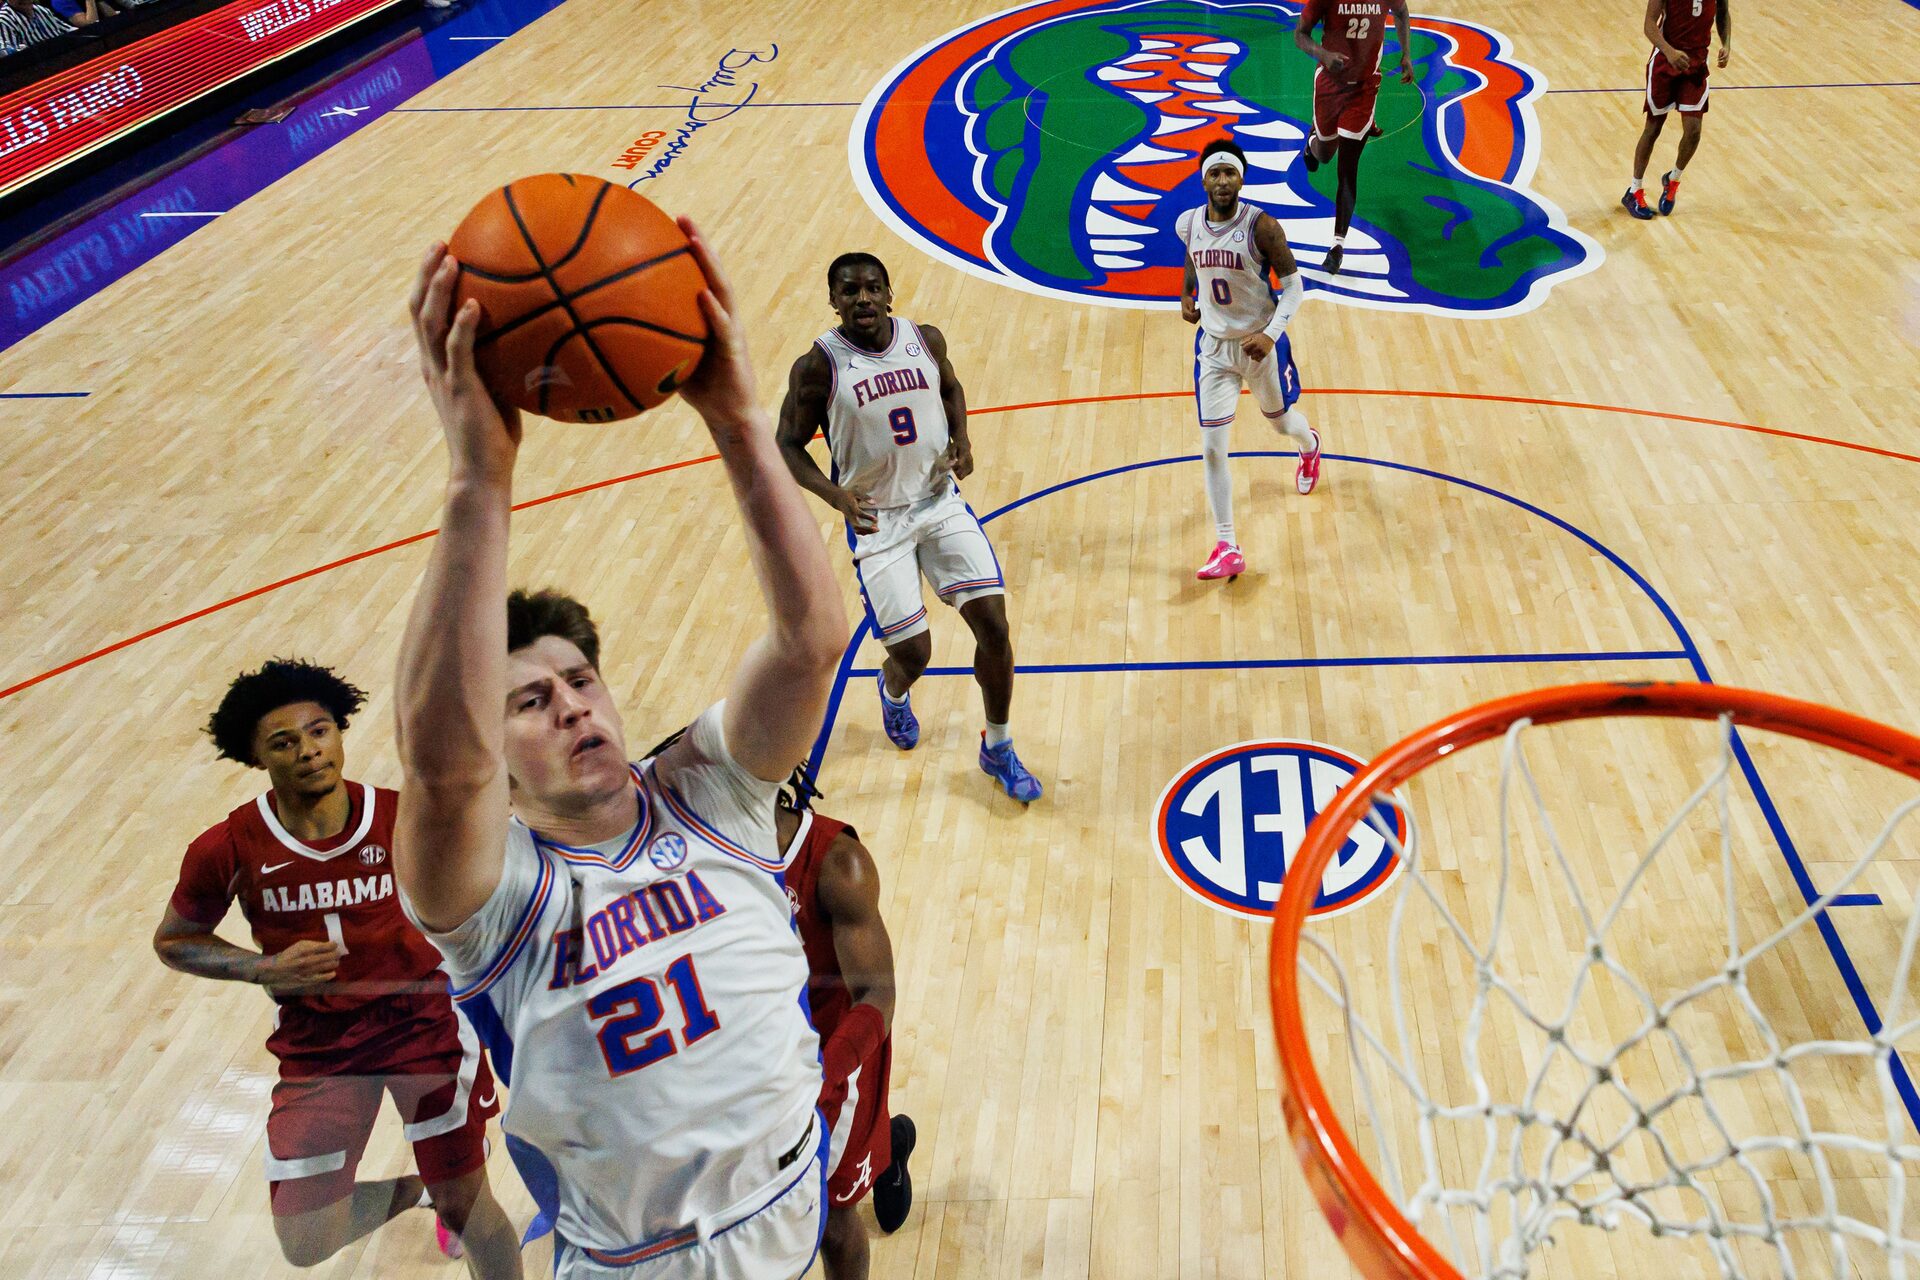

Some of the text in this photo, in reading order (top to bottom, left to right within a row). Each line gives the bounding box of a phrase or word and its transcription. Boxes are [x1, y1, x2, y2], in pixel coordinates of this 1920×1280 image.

[1338, 3, 1381, 15] ALABAMA
[1346, 17, 1371, 39] 22
[1692, 0, 1703, 17] 5
[46, 65, 143, 130] FARGO
[610, 130, 667, 170] COURT
[1192, 249, 1245, 271] FLORIDA
[1211, 277, 1233, 306] 0
[852, 367, 930, 408] FLORIDA
[888, 406, 918, 446] 9
[360, 846, 385, 865] SEC
[262, 873, 393, 912] ALABAMA
[323, 912, 350, 957] 1
[547, 869, 727, 990] FLORIDA
[586, 953, 721, 1078] 21
